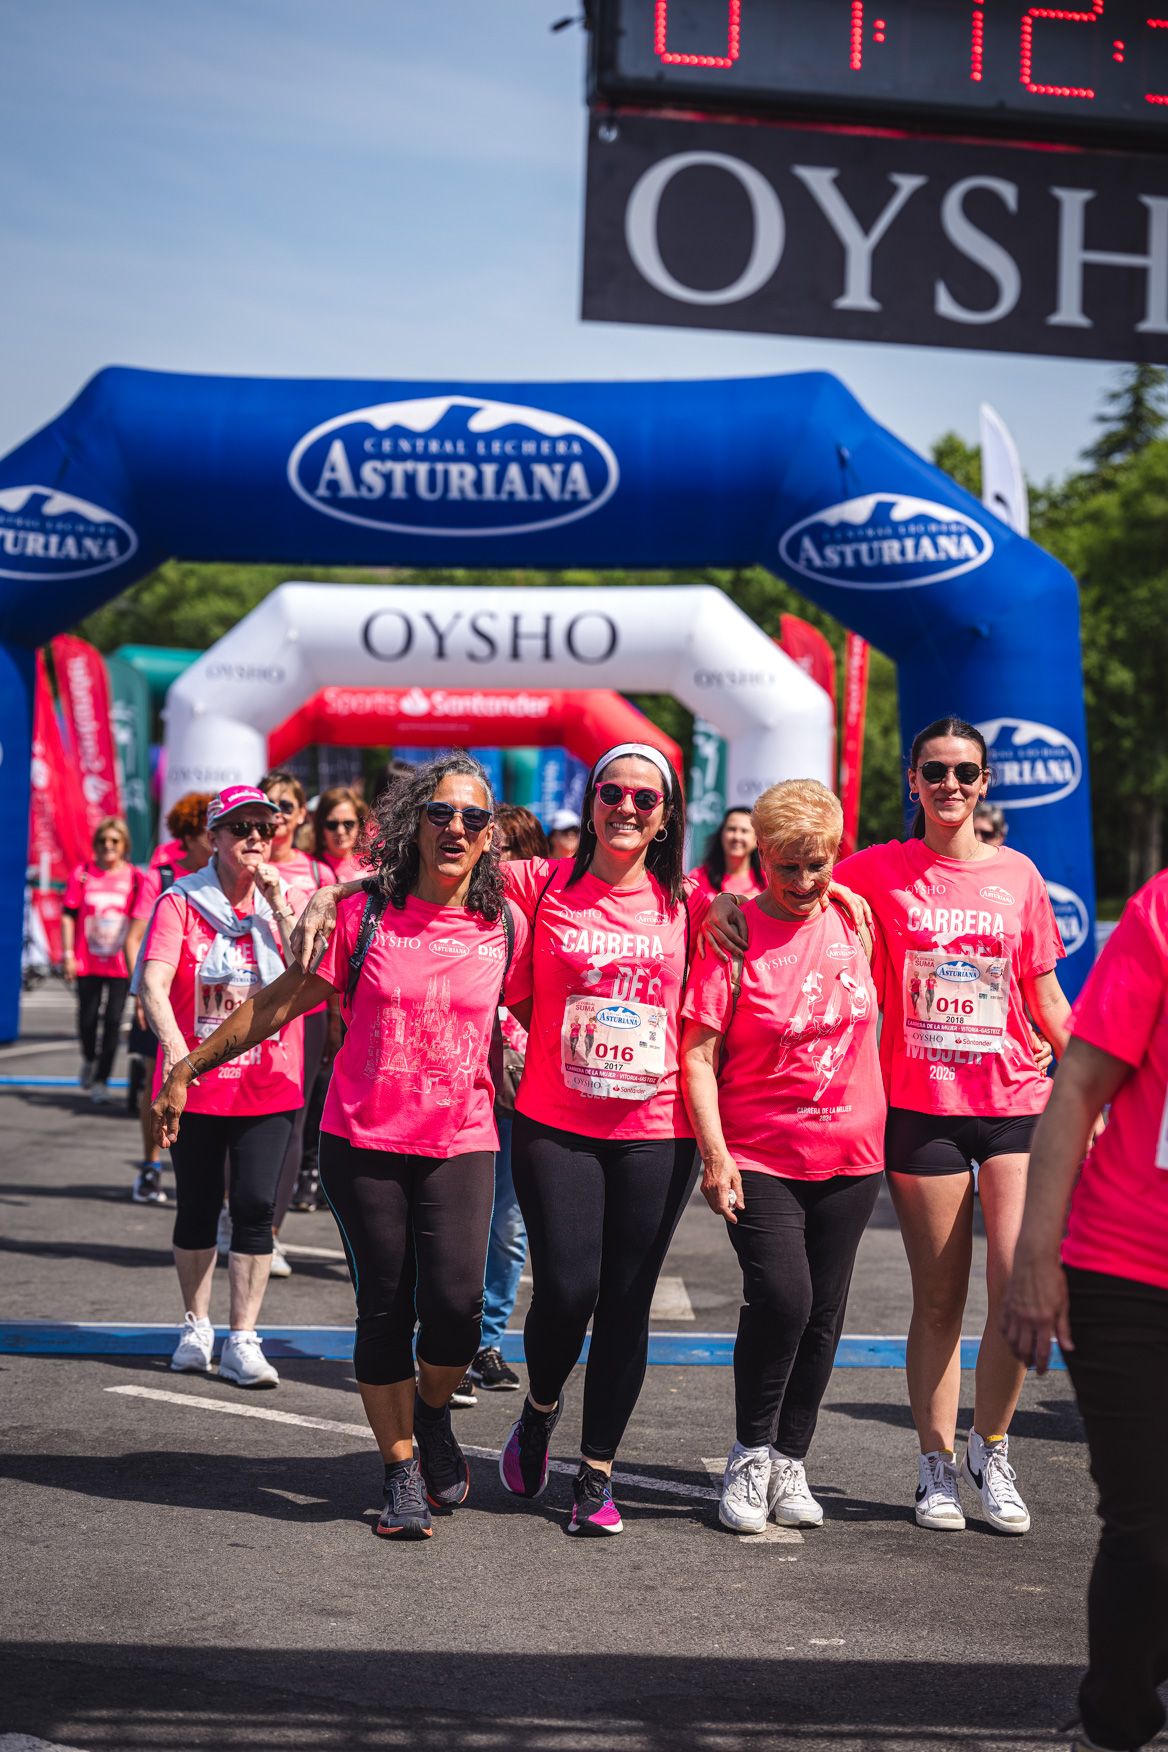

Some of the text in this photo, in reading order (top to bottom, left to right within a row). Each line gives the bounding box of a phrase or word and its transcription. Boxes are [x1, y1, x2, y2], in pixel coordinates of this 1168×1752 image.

[363, 437, 583, 457] CENTRAL LECHERA
[315, 439, 593, 502] ASTURIANA
[0, 527, 119, 560] URIANA
[800, 533, 980, 568] ASTURIANA
[361, 607, 620, 665] OYSHO
[324, 686, 551, 718] Sports Santander
[905, 884, 946, 895] OYSHO
[560, 909, 602, 919] OYSHO
[907, 906, 1004, 939] CARRERA
[562, 929, 665, 960] CARRERA
[756, 954, 798, 972] OYSHO
[939, 967, 977, 978] ASTURIANA
[576, 1004, 596, 1013] SUMA
[936, 997, 974, 1015] 016
[600, 1012, 638, 1025] ASTURIANA
[945, 1016, 964, 1024] 2018
[912, 1032, 943, 1043] OYSHO
[962, 1038, 992, 1047] Santander
[595, 1043, 634, 1062] 016
[604, 1062, 624, 1071] 2017
[929, 1065, 956, 1081] 2026
[573, 1077, 601, 1090] OYSHO
[797, 1106, 820, 1115] CARRERA
